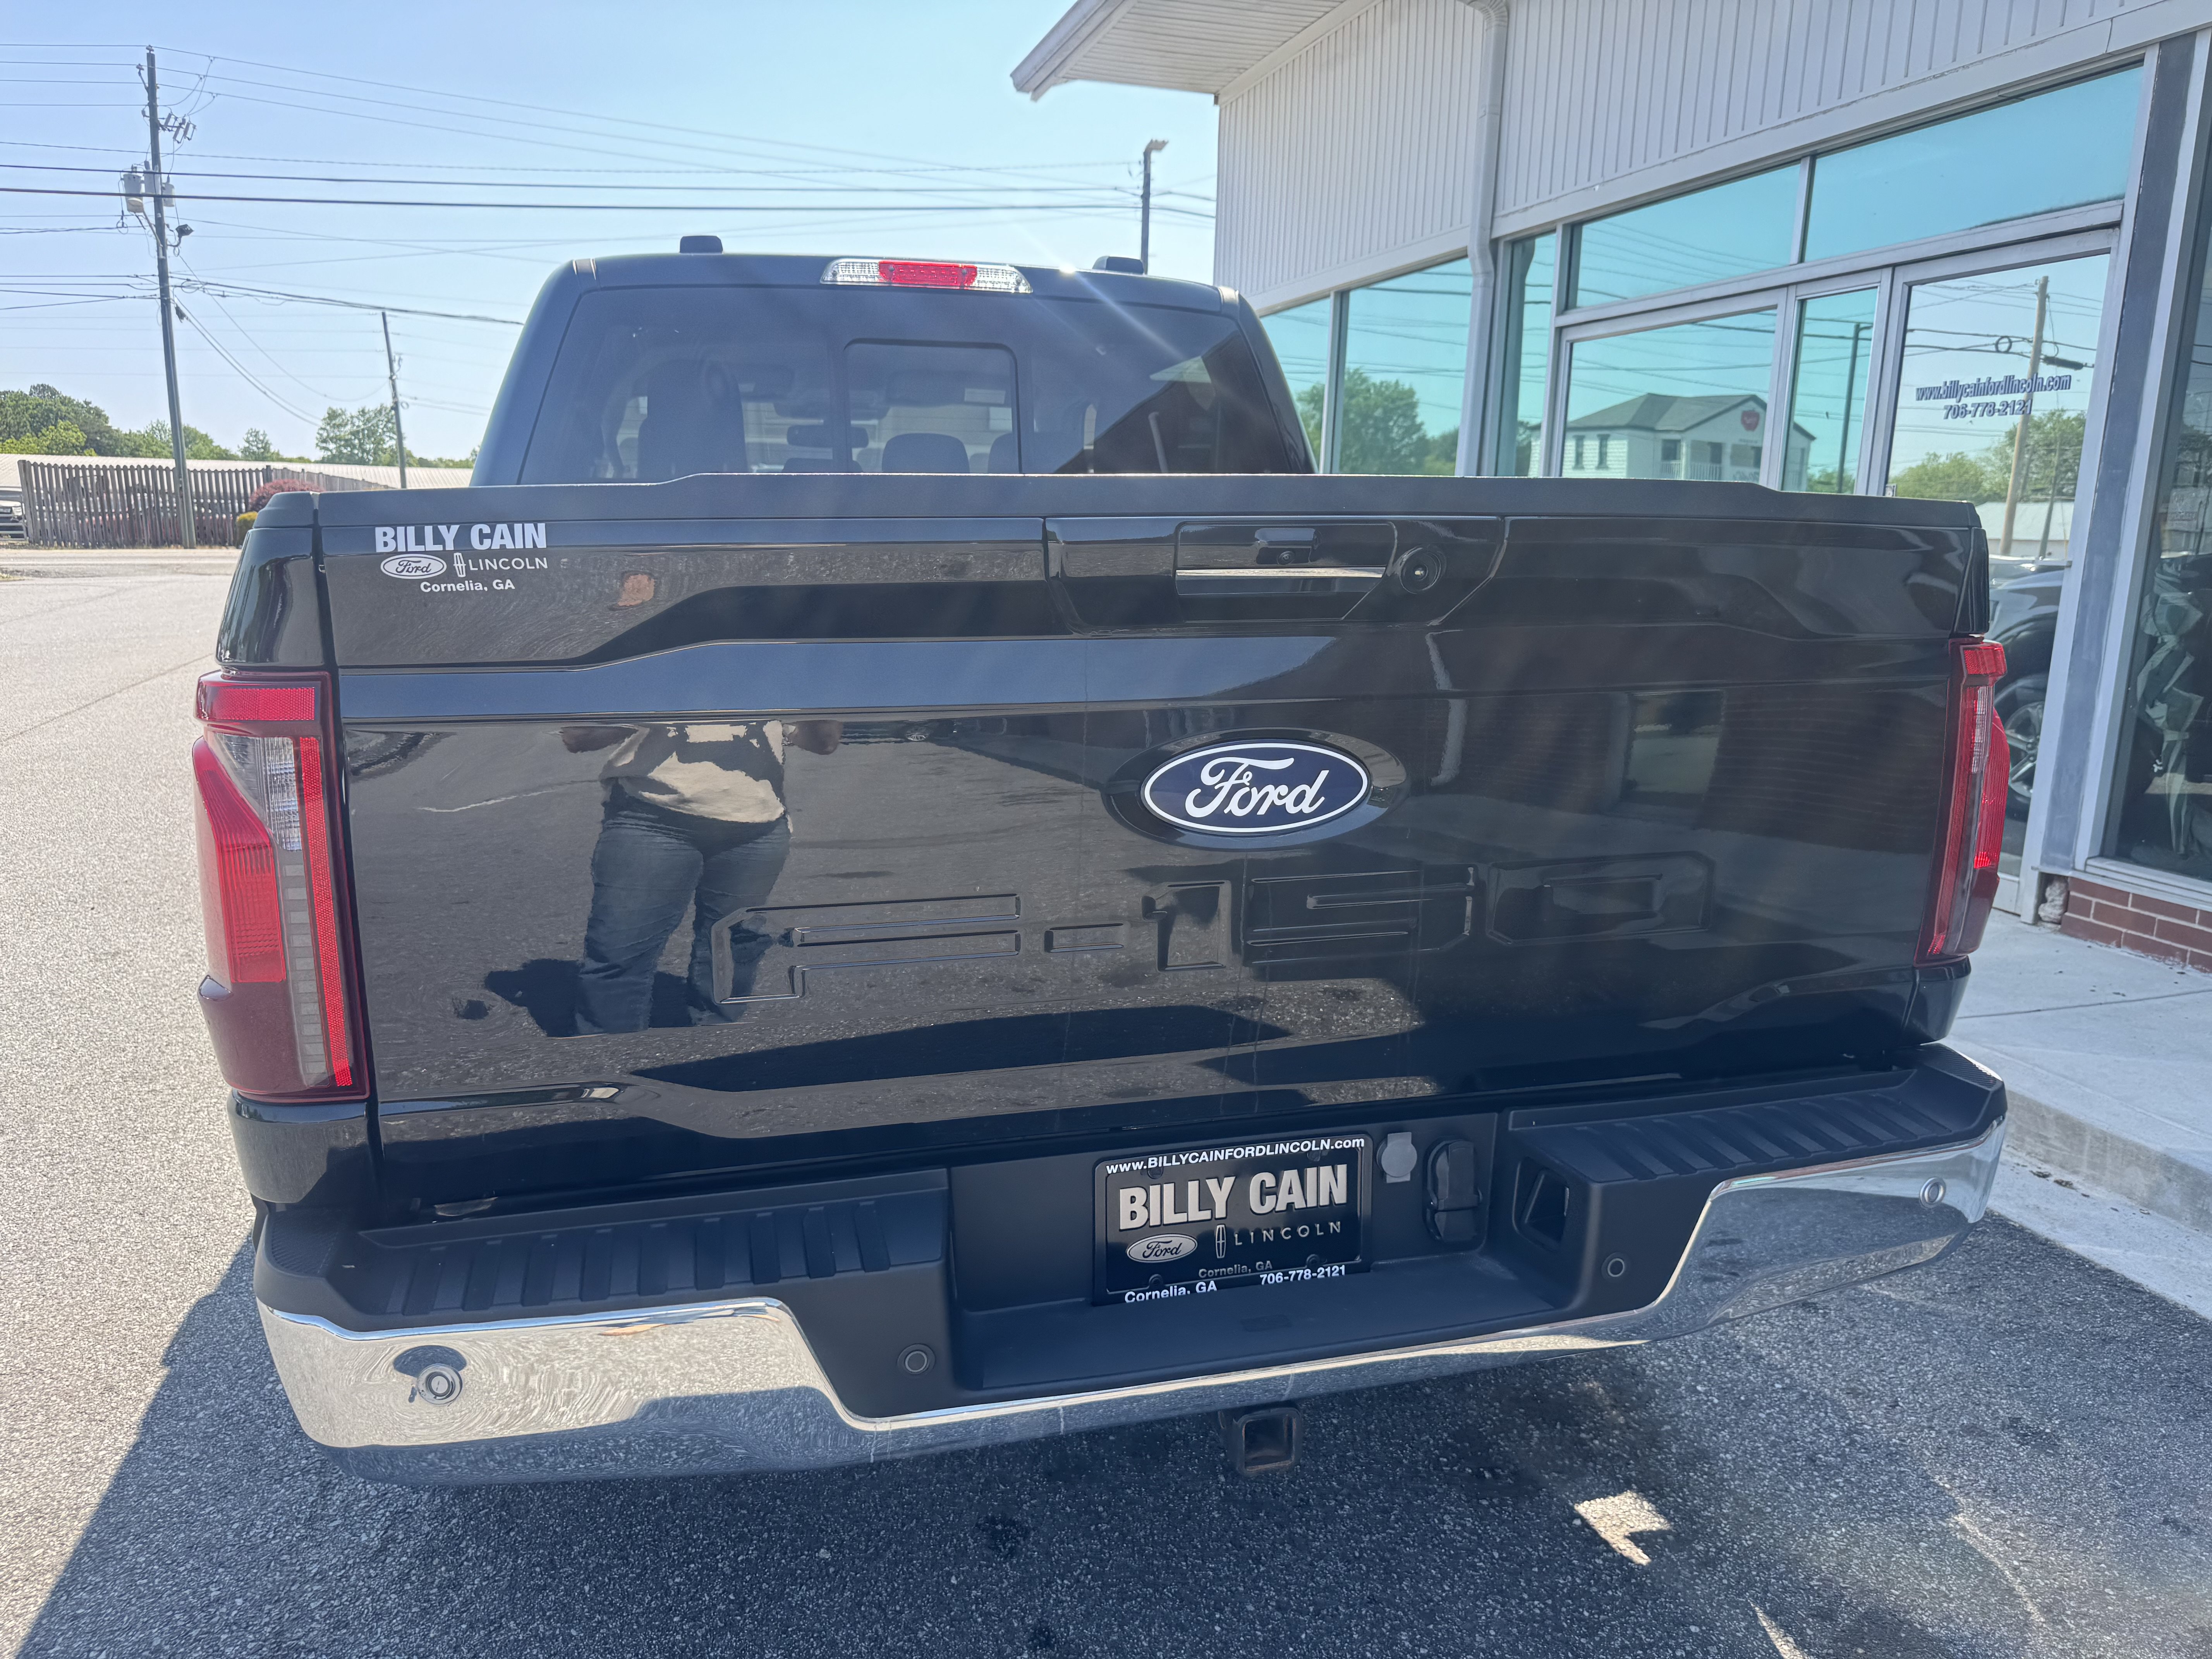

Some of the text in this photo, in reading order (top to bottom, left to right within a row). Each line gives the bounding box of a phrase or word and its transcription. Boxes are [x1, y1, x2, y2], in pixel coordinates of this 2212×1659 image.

[1915, 373, 2071, 403] www.billycainfordlincoln.com
[1943, 399, 2033, 419] 706-778-2121
[375, 523, 547, 552] BILLY CAIN
[395, 560, 431, 574] Ford
[469, 557, 548, 571] LINCOLN
[420, 579, 515, 592] Cornelia, GA
[1185, 757, 1329, 817] Ford
[1106, 1138, 1365, 1174] www.BILLYCAINFORDLINCOLN.com
[1119, 1164, 1348, 1231] BILLY CAIN
[1235, 1221, 1341, 1246] LINCOLN
[1142, 1240, 1183, 1258] Ford
[1199, 1261, 1273, 1278] Cornelia, GA
[1260, 1265, 1346, 1285] 706-778-2121
[1195, 1280, 1217, 1293] GA
